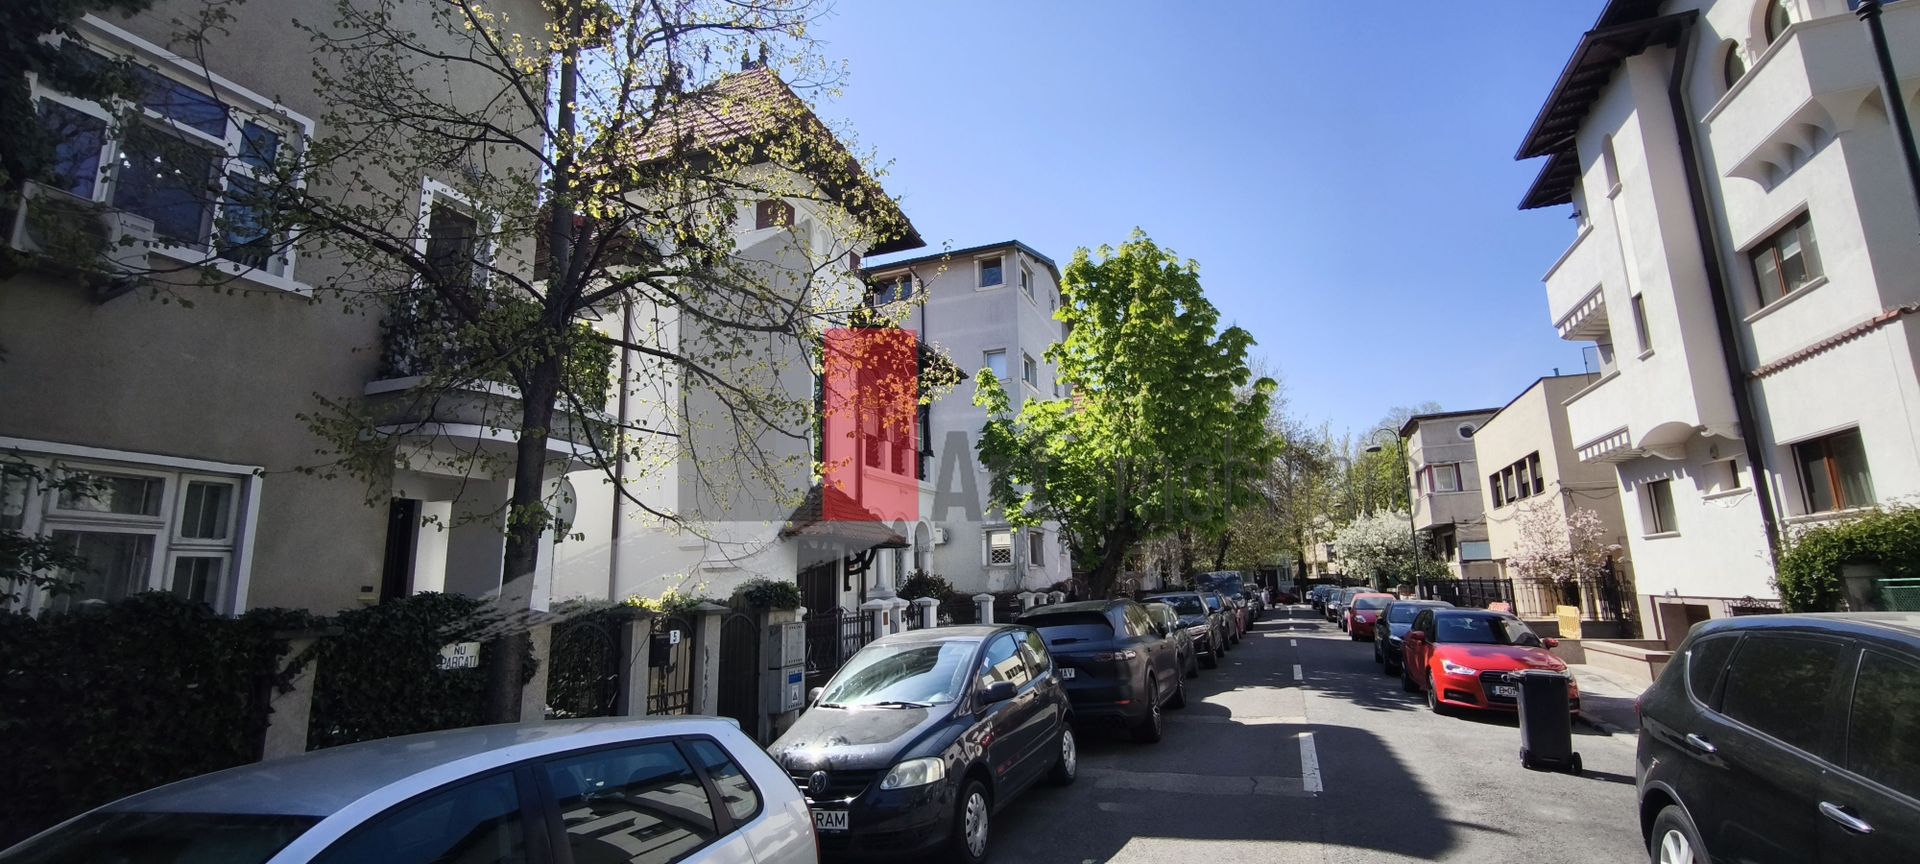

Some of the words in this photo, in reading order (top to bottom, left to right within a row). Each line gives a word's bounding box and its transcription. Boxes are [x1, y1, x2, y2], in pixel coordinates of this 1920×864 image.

[672, 631, 678, 642] 5
[453, 645, 467, 656] NU
[816, 812, 845, 827] RAM
